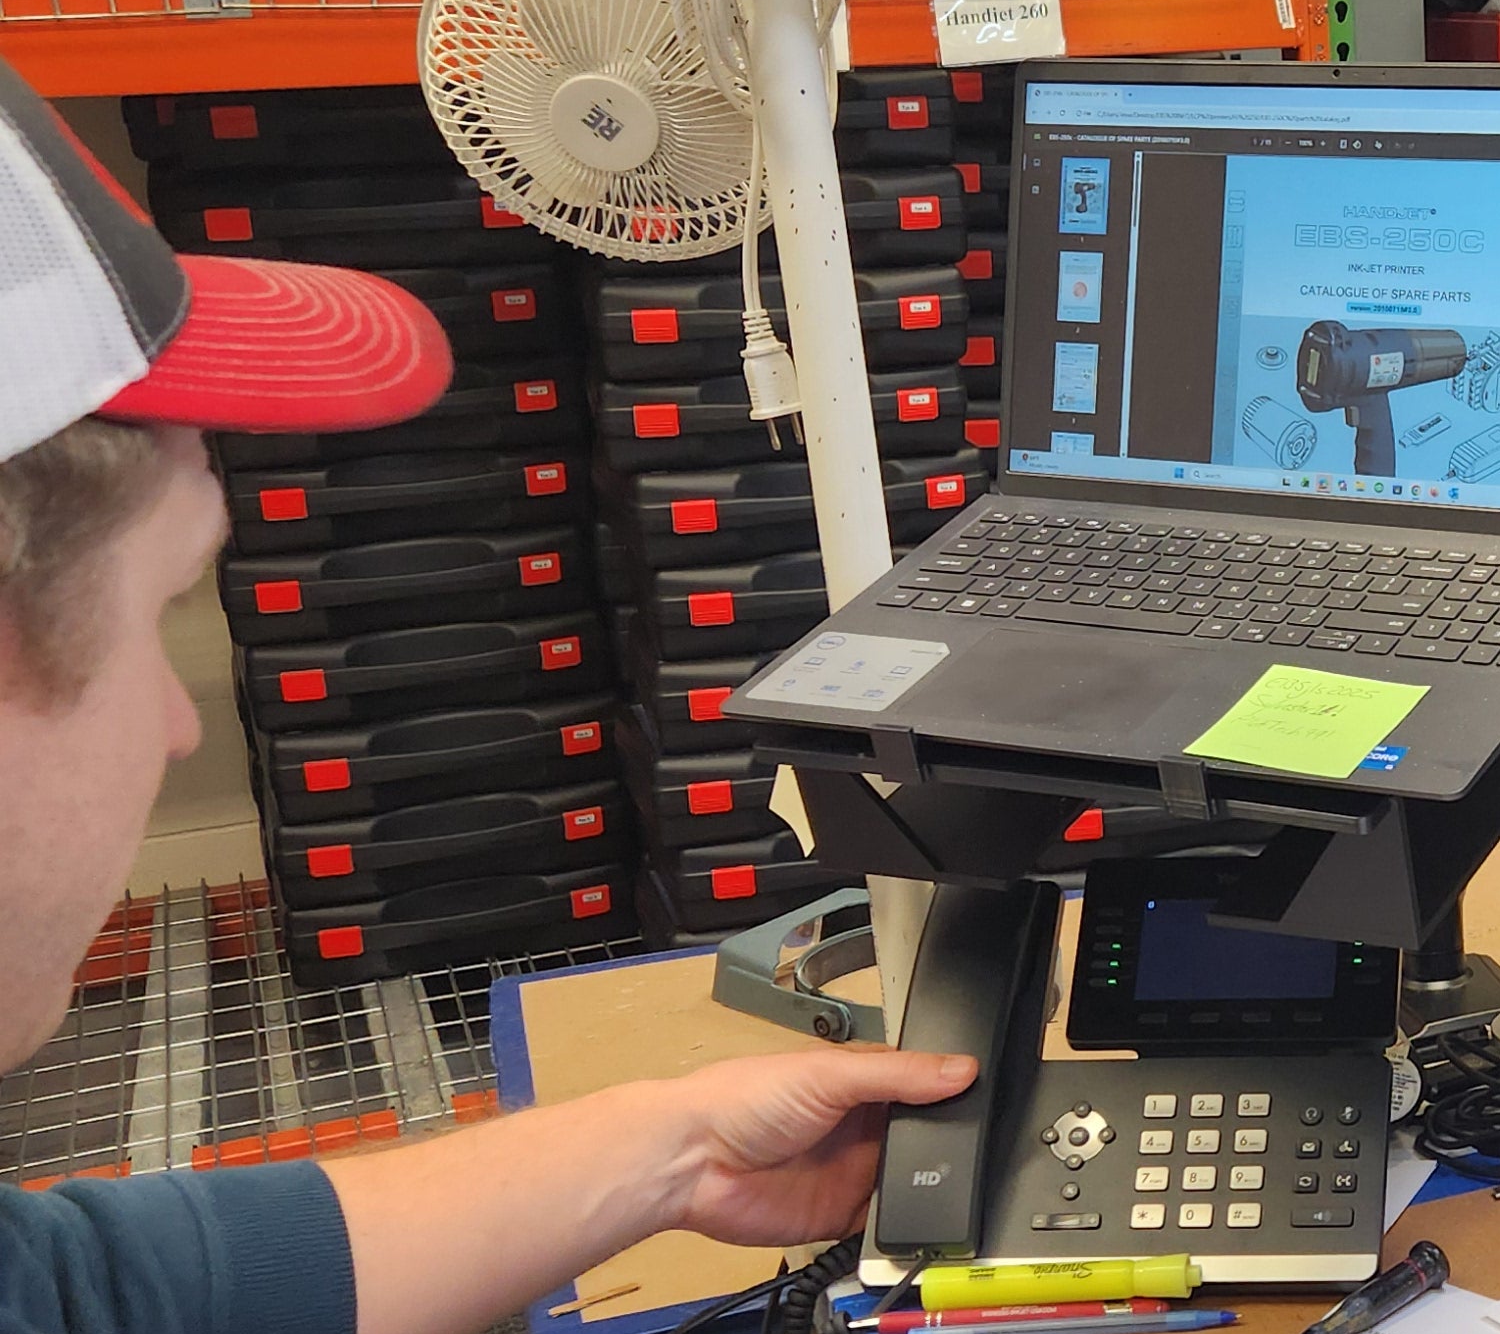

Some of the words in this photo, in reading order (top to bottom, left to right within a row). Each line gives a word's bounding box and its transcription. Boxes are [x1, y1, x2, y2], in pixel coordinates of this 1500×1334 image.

[1019, 3, 1048, 19] 260
[1294, 223, 1485, 254] EBS-250C
[1348, 263, 1382, 274] INK-JET
[1384, 264, 1425, 275] PRINTER
[1300, 285, 1368, 299] CATALOGUE
[1373, 288, 1388, 299] OF
[1391, 289, 1429, 301] SPARE
[1433, 291, 1471, 302] PARTS
[913, 1171, 941, 1186] HD
